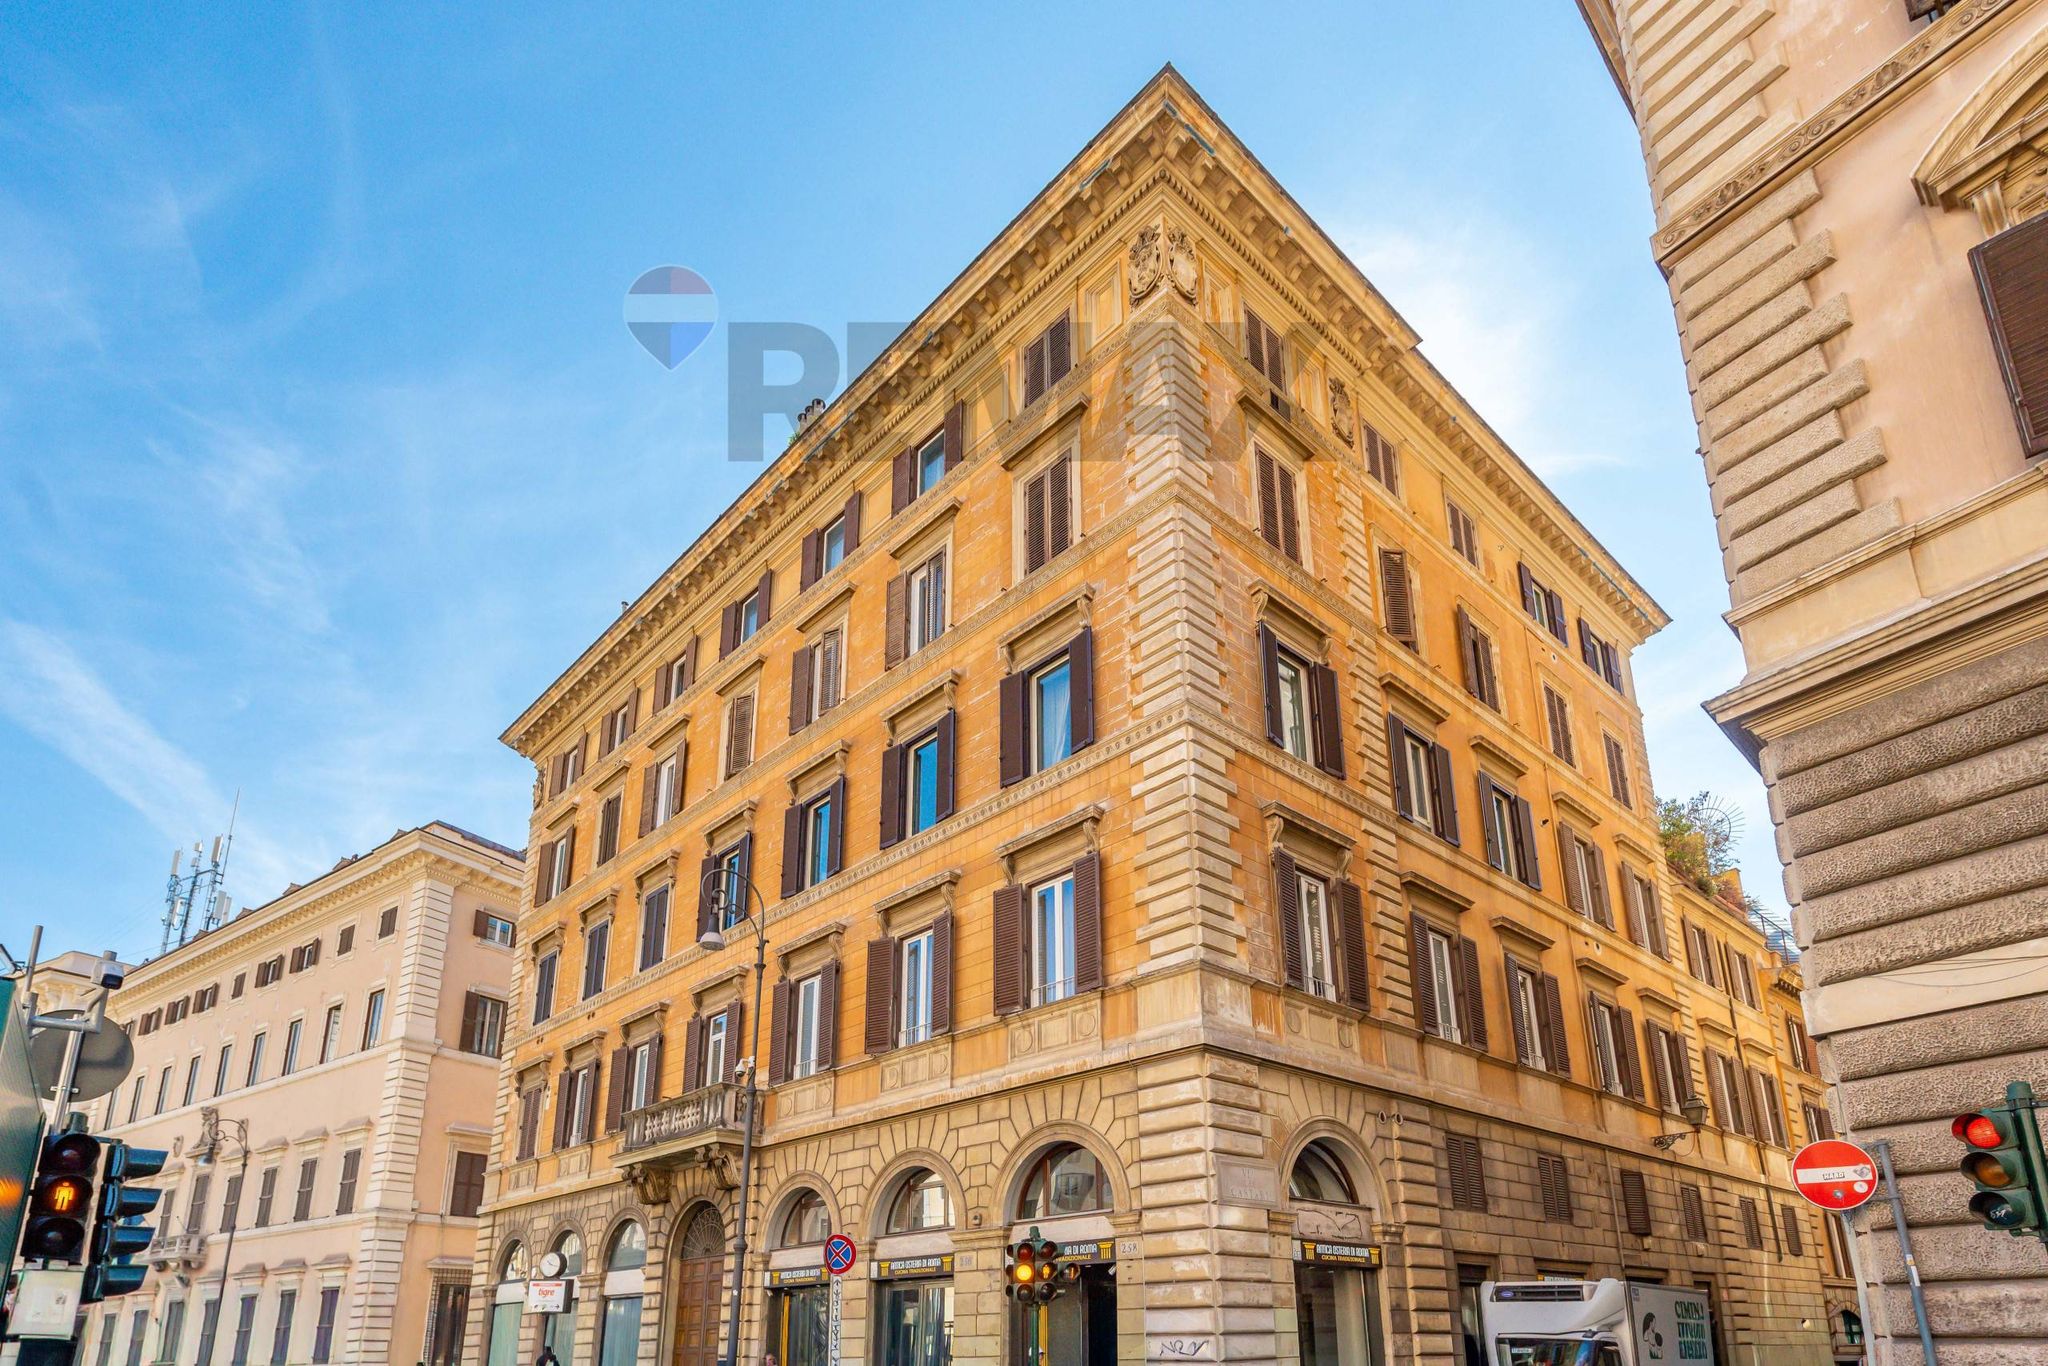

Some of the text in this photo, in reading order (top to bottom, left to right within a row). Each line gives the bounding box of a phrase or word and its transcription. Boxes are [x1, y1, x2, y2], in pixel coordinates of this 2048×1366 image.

[1073, 1245, 1079, 1255] DI
[1079, 1243, 1098, 1254] ROMA
[1120, 1242, 1138, 1254] 258
[1316, 1244, 1333, 1255] ANTICA
[1333, 1245, 1351, 1256] OSTERIA
[1355, 1247, 1370, 1258] ROMA
[890, 1260, 905, 1270] ANTICA
[904, 1259, 922, 1269] OSTERIA
[927, 1257, 942, 1267] ROMA
